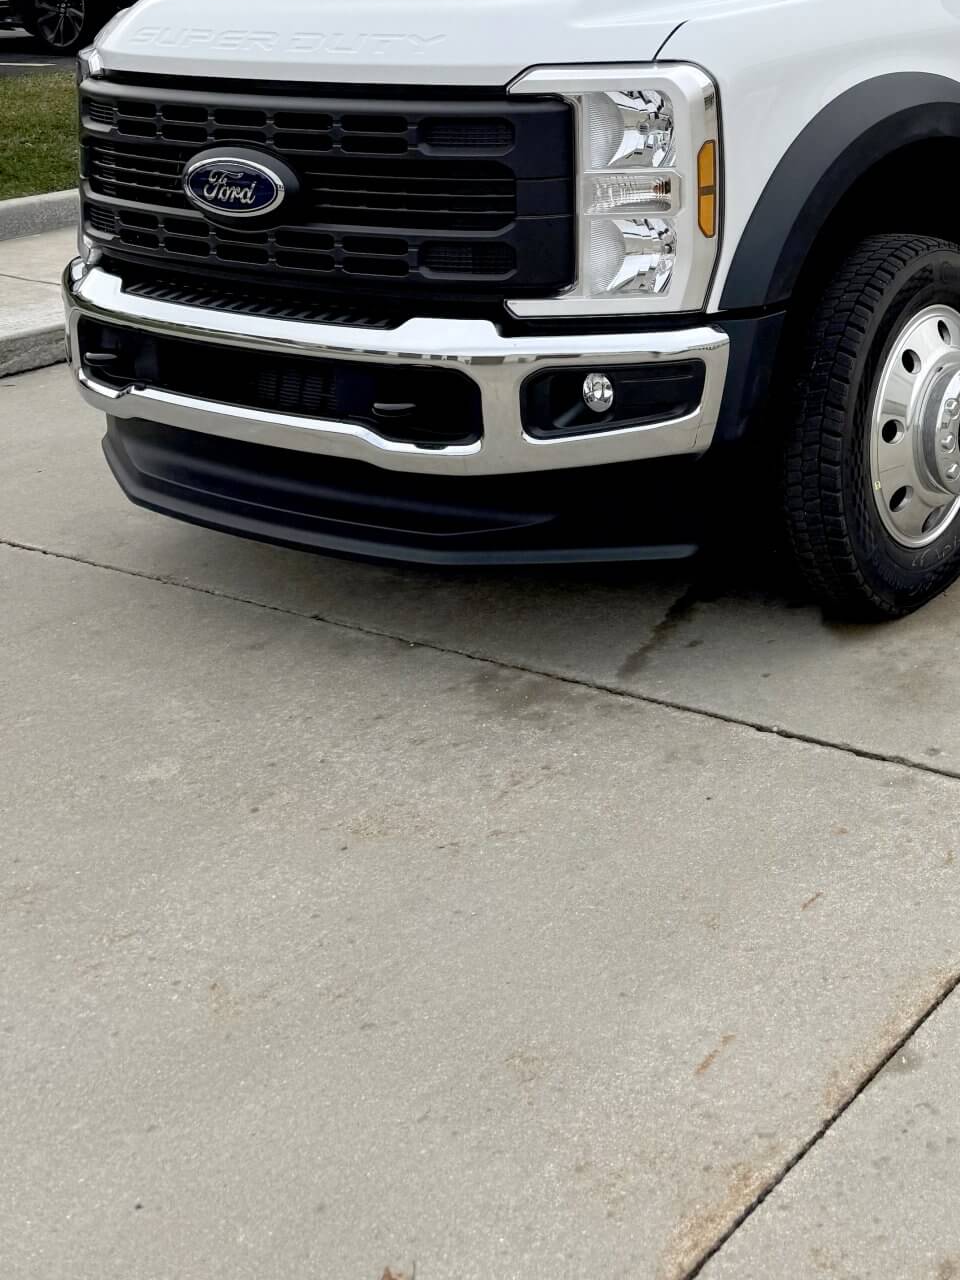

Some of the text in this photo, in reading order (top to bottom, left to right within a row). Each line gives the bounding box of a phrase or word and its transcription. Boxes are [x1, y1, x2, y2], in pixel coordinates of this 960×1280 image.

[130, 26, 448, 55] SUPER DUTY
[203, 169, 257, 204] Ford
